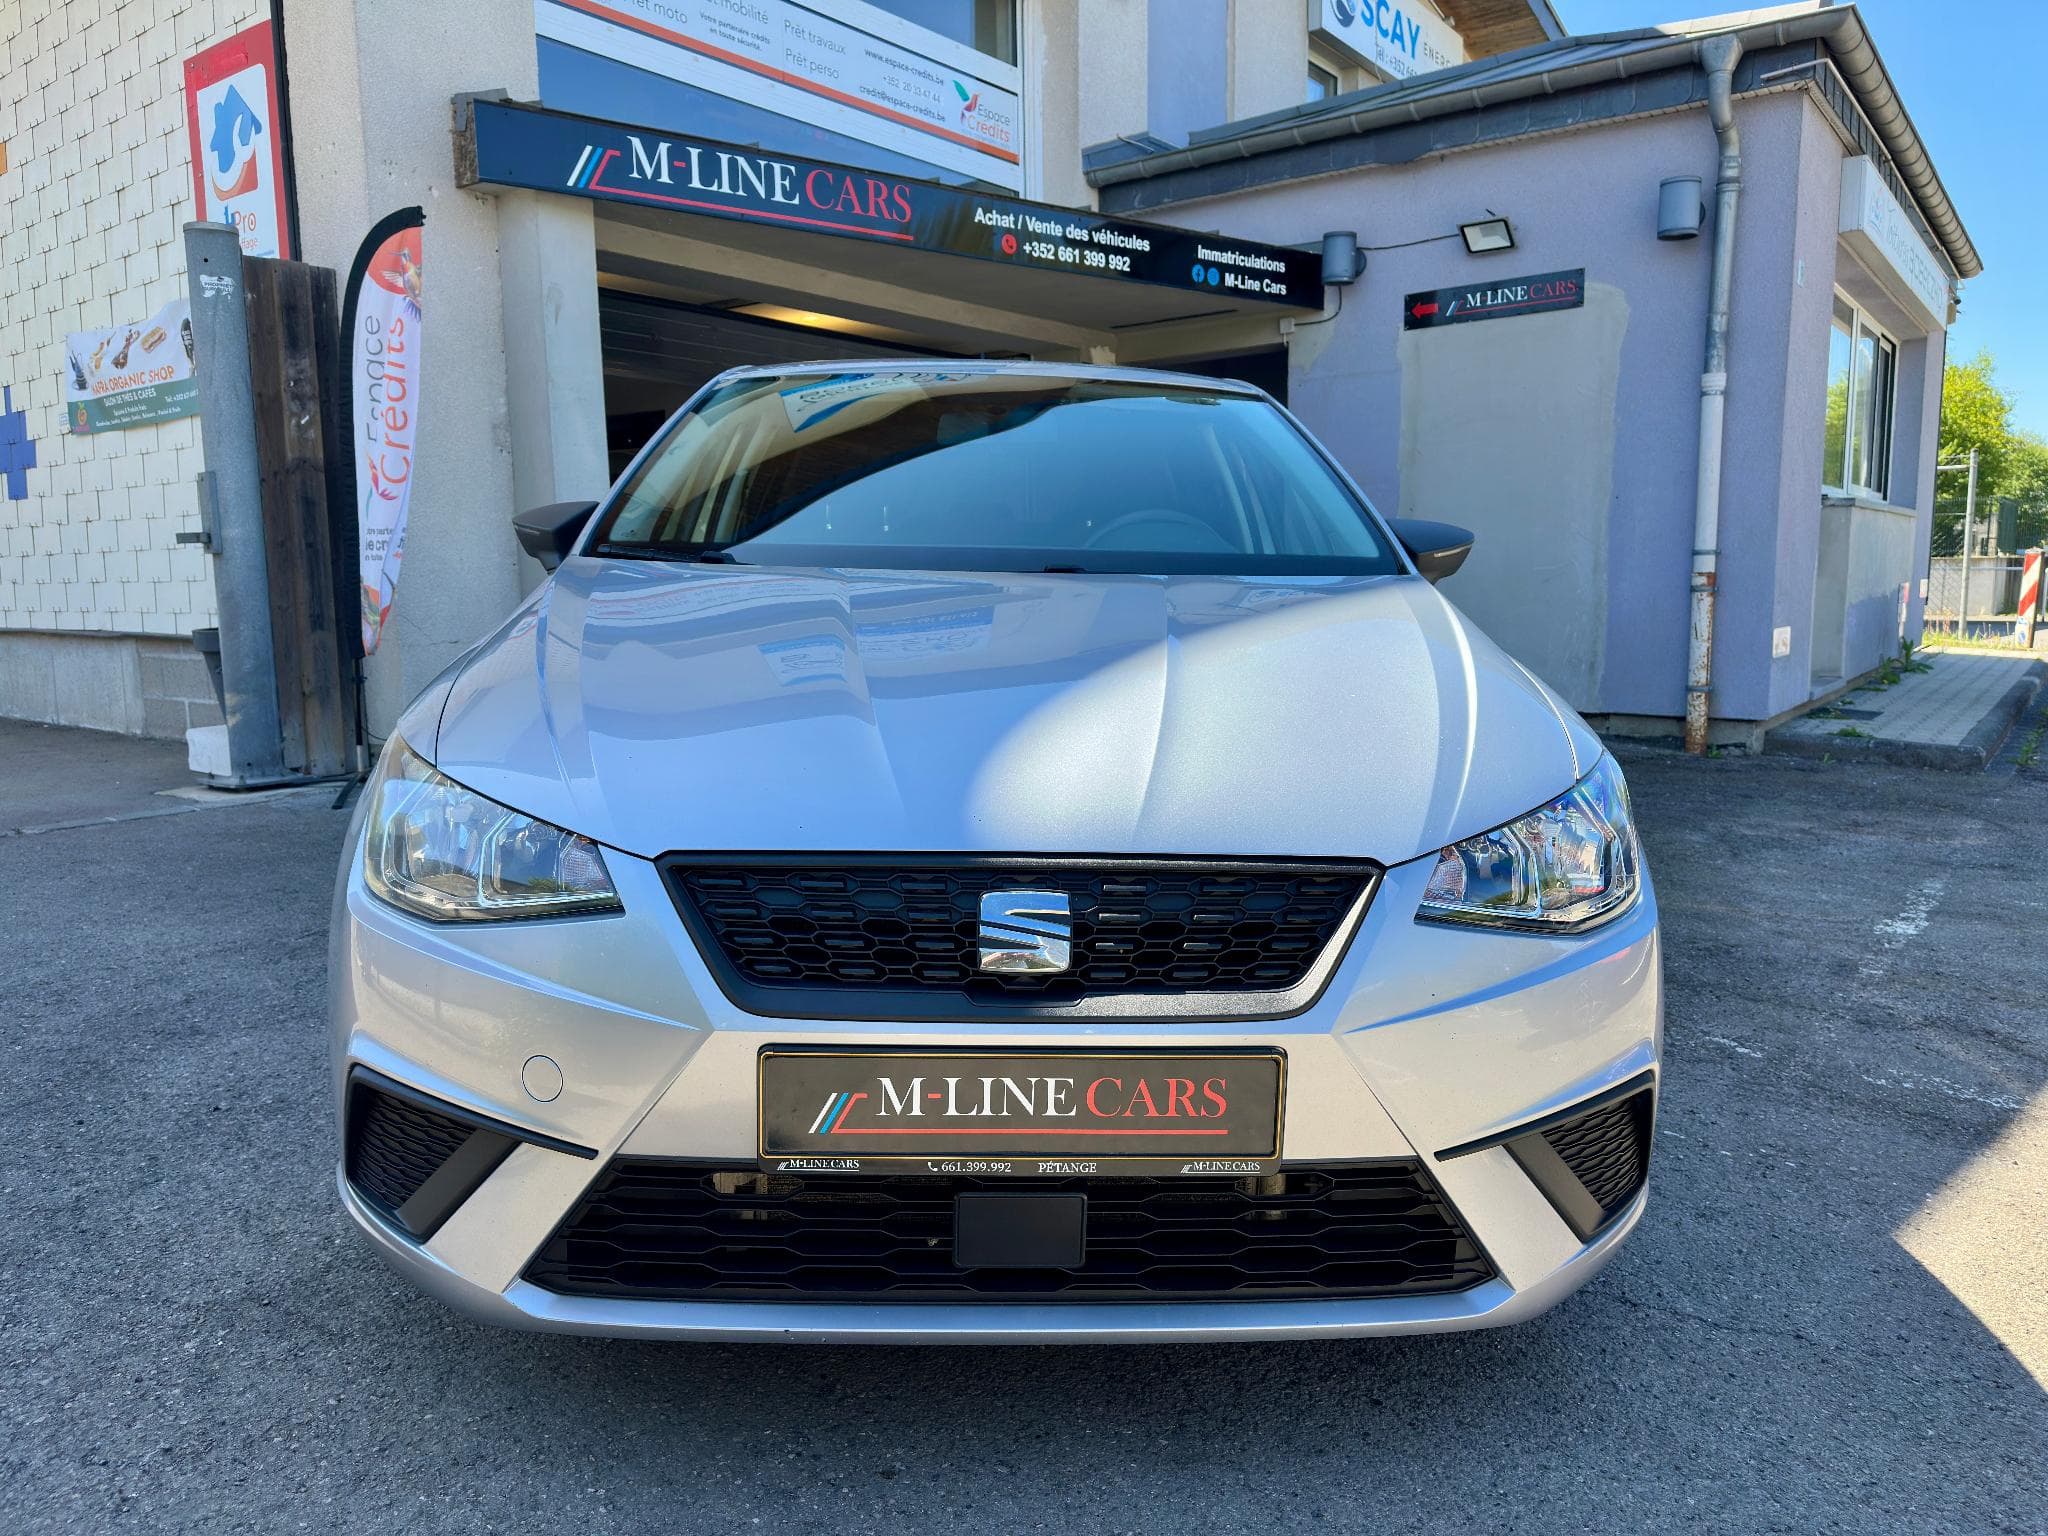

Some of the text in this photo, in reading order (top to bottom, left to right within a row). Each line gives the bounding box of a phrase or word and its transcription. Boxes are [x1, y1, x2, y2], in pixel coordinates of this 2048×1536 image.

[654, 4, 687, 24] moto
[784, 19, 847, 55] Prêt travaux
[1361, 0, 1420, 60] SCAY
[785, 48, 840, 79] Prêt perso
[977, 104, 1011, 126] Espace
[627, 135, 914, 224] M-LINE CARS
[974, 207, 1015, 230] Achat
[1025, 215, 1063, 237] Vente
[1066, 224, 1089, 241] des
[1092, 228, 1151, 252] véhicules
[1023, 241, 1131, 272] +352 661 399 992
[1197, 244, 1286, 273] Immatriculations
[1224, 272, 1287, 295] M-Line Cars
[1466, 279, 1577, 307] M-LINE CARS
[109, 371, 146, 392] ORGANIC
[149, 365, 175, 384] SHOP
[877, 1076, 1228, 1119] M-LINE CARS
[789, 1159, 860, 1169] M-LINE CARS
[941, 1161, 1012, 1173] 661.399.992
[1038, 1160, 1097, 1174] PÉTANGE
[1194, 1161, 1261, 1171] M-LINE CARS
